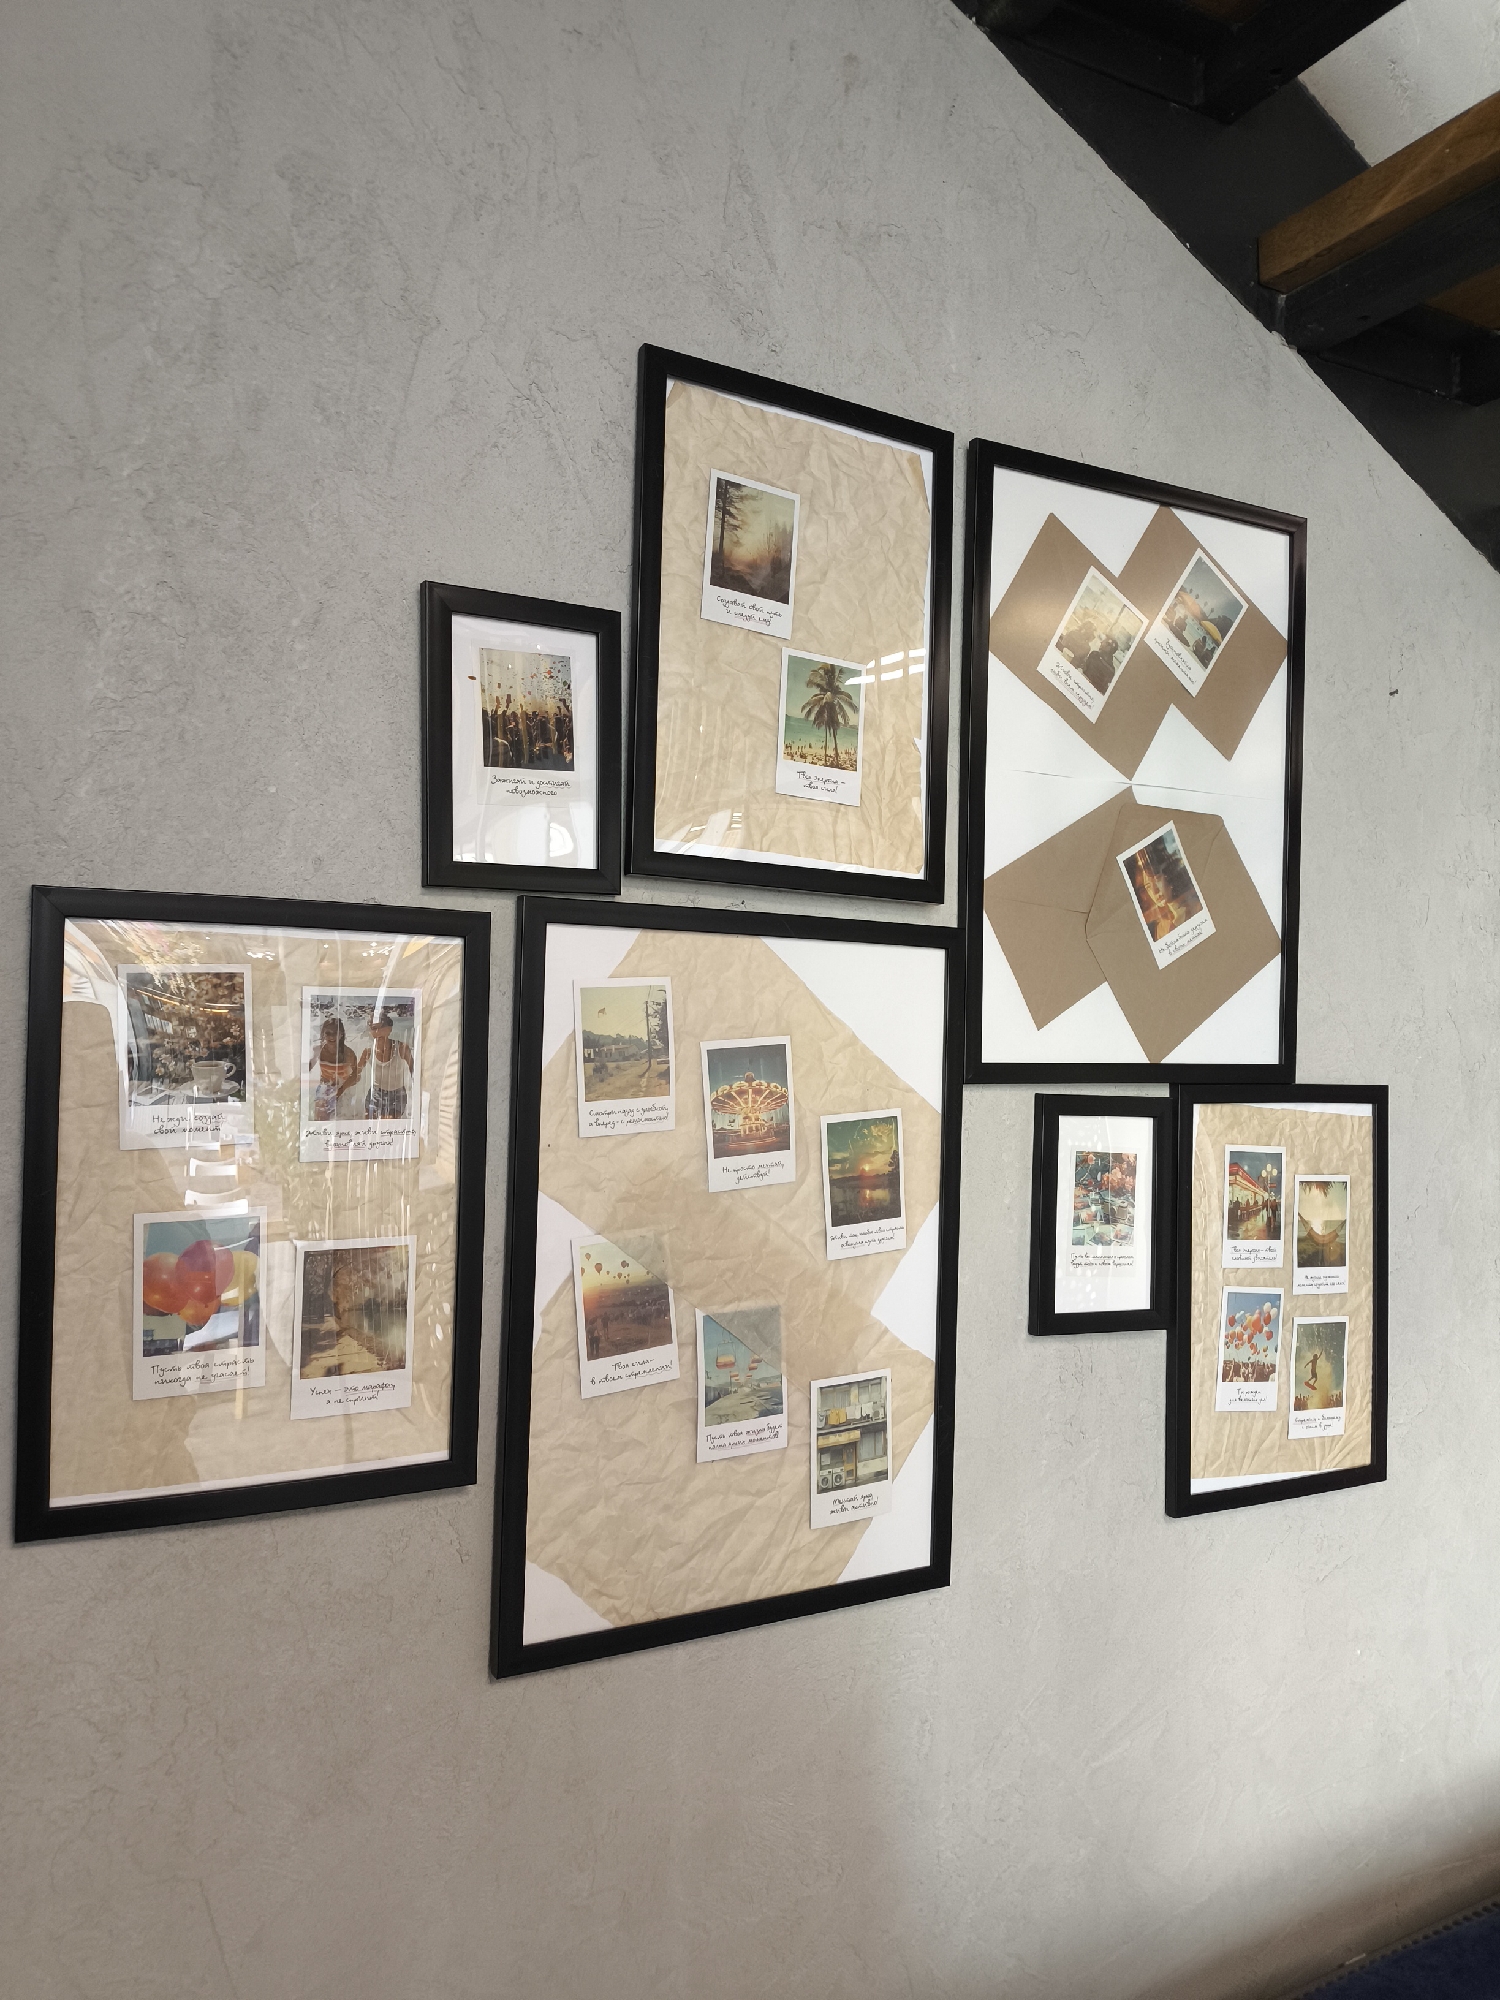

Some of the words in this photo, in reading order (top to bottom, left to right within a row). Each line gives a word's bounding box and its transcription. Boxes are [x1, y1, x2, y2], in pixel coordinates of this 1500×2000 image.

[152, 1115, 166, 1123] Не
[194, 1113, 226, 1125] создай
[153, 1125, 177, 1135] свой
[150, 1364, 182, 1377] Пусть
[187, 1360, 210, 1370] твоя
[154, 1376, 191, 1387] никогда
[706, 1434, 725, 1444] Пусть
